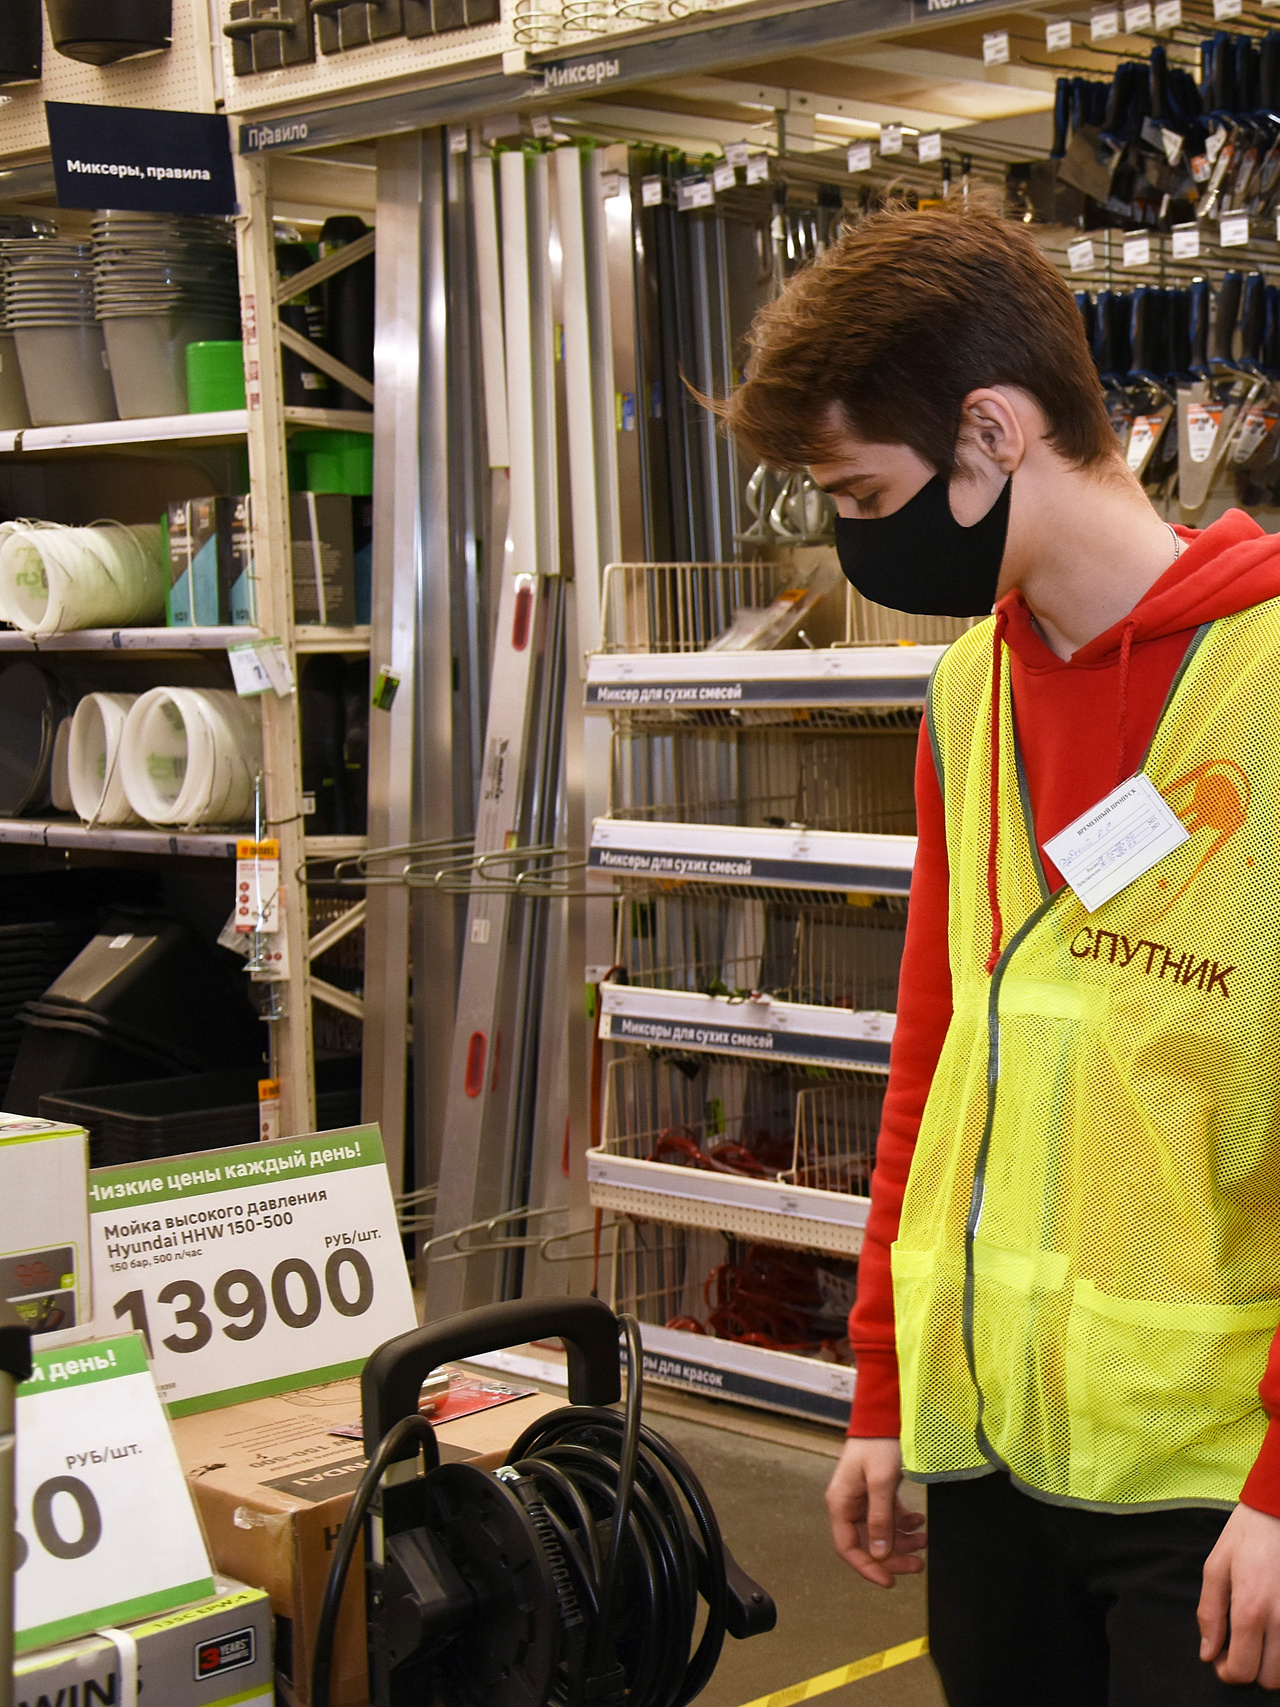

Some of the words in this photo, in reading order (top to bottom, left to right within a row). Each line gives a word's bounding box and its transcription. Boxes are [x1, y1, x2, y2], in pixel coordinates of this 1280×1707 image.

[544, 59, 620, 88] Миксеры
[248, 123, 308, 150] Правило
[67, 160, 144, 179] Миксеры,
[147, 167, 211, 181] правила
[597, 686, 639, 703] Миксер
[639, 688, 662, 703] для
[663, 687, 698, 704] сухих
[700, 683, 742, 700] смесей
[1077, 807, 1112, 836] ВРЕМЕННЫЙ
[1110, 788, 1137, 811] ПРОПУСК
[600, 851, 650, 870] Миксеры
[650, 857, 673, 872] для
[674, 858, 708, 874] сухих
[709, 860, 752, 875] смесей
[1070, 926, 1237, 998] СПУТНИК
[621, 1019, 672, 1040] Миксеры
[672, 1026, 695, 1042] для
[696, 1028, 730, 1045] сухих
[731, 1033, 774, 1049] смесей
[167, 1167, 222, 1191] цены
[224, 1149, 306, 1179] каждый
[310, 1141, 362, 1168] день!
[104, 1220, 161, 1240] Мойка
[165, 1205, 243, 1229] высокого
[247, 1190, 327, 1217] давления
[107, 1232, 178, 1259] Hyundai
[182, 1224, 223, 1245] HHW
[227, 1211, 293, 1236] 150-500
[324, 1229, 382, 1248] РУБ/шт.
[110, 1261, 128, 1273] 150
[130, 1258, 152, 1269] бар,
[154, 1253, 172, 1264] 500
[174, 1248, 203, 1261] л/час
[113, 1247, 375, 1360] 13900
[49, 1349, 117, 1383] день!
[658, 1360, 681, 1375] для
[683, 1366, 724, 1387] красок
[65, 1443, 143, 1469] РУБ/шт.
[249, 1445, 331, 1469] 150-500
[292, 1459, 371, 1487] NDAI
[14, 1475, 103, 1573] 0
[200, 1647, 220, 1670] 3
